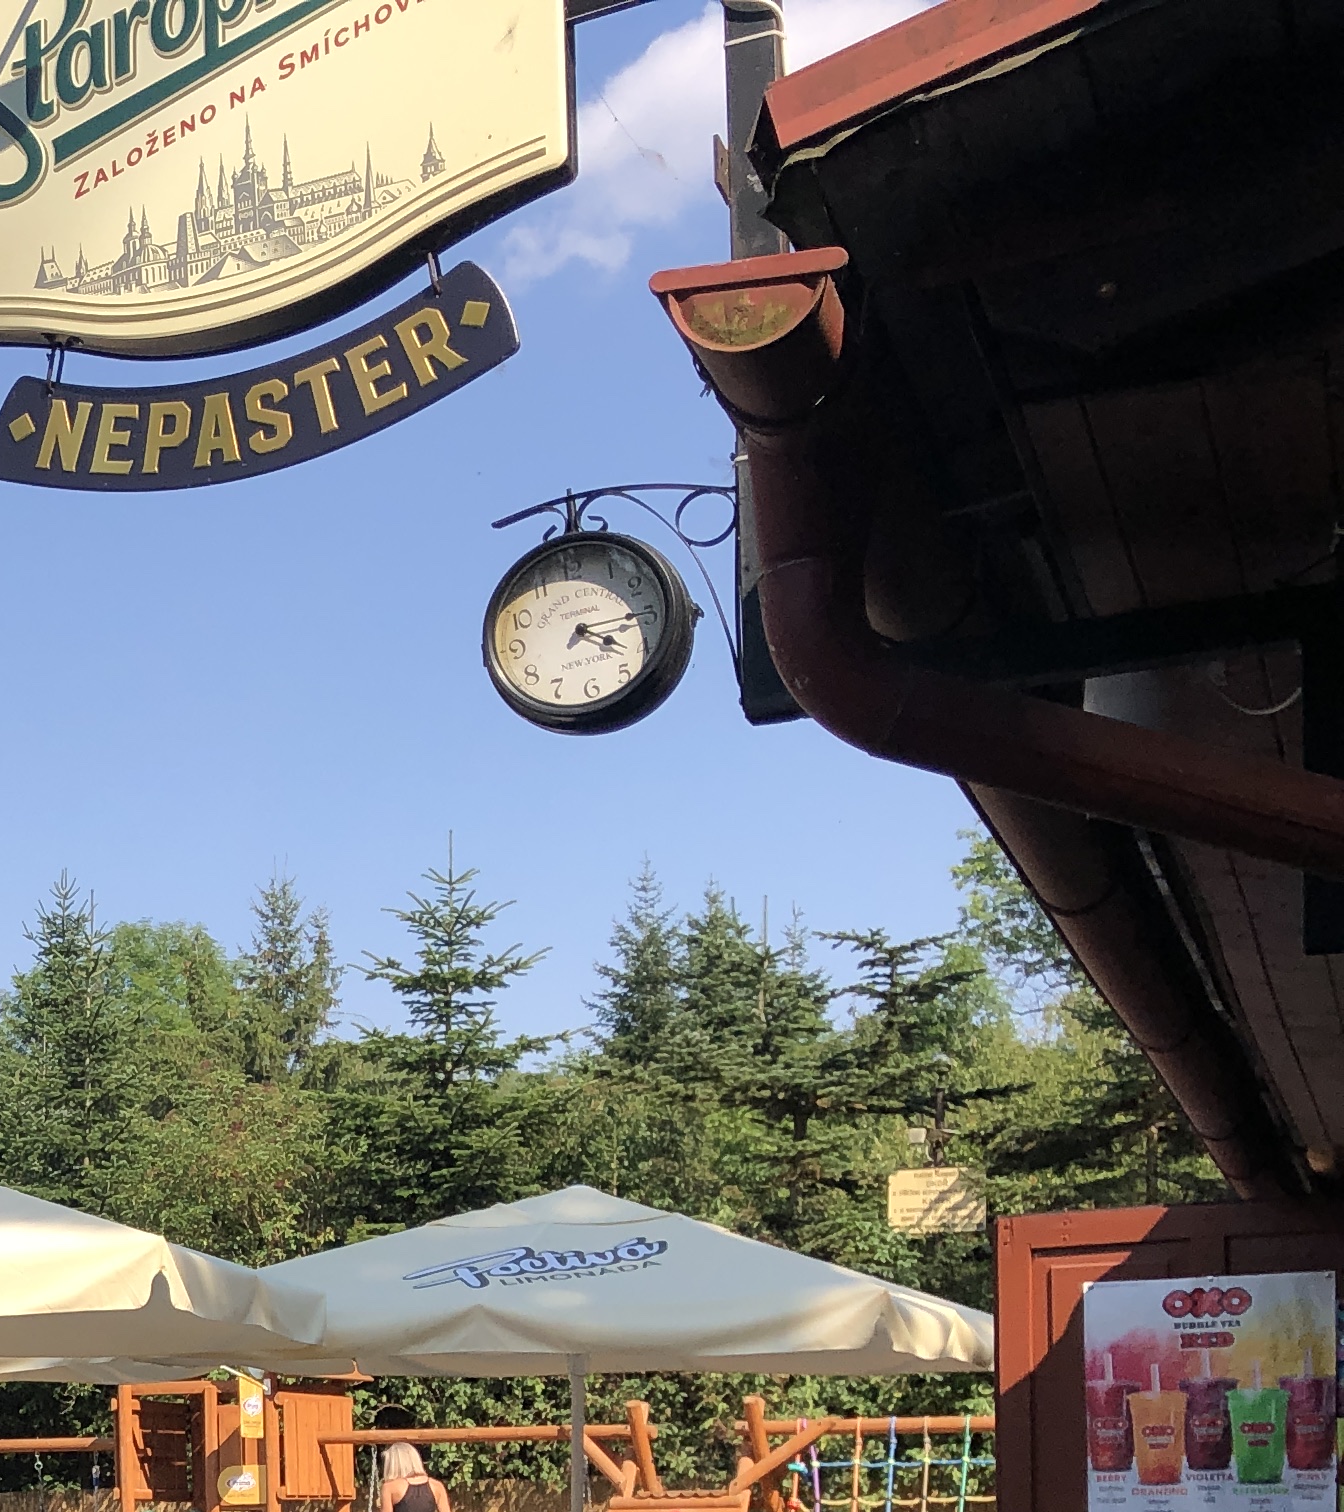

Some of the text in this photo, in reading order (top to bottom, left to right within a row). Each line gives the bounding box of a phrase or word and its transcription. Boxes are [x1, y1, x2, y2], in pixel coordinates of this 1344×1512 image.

[73, 0, 426, 200] ZALOŽENO NA SMÍCHOV
[34, 306, 470, 476] NEPASTER
[537, 587, 624, 629] GRAND CENTRAL
[512, 608, 533, 632] 10
[508, 638, 526, 660] 9
[561, 652, 614, 672] NEW YORK
[617, 662, 632, 684] 5
[523, 664, 540, 686] 8
[550, 677, 564, 700] 7
[583, 677, 601, 699] 6
